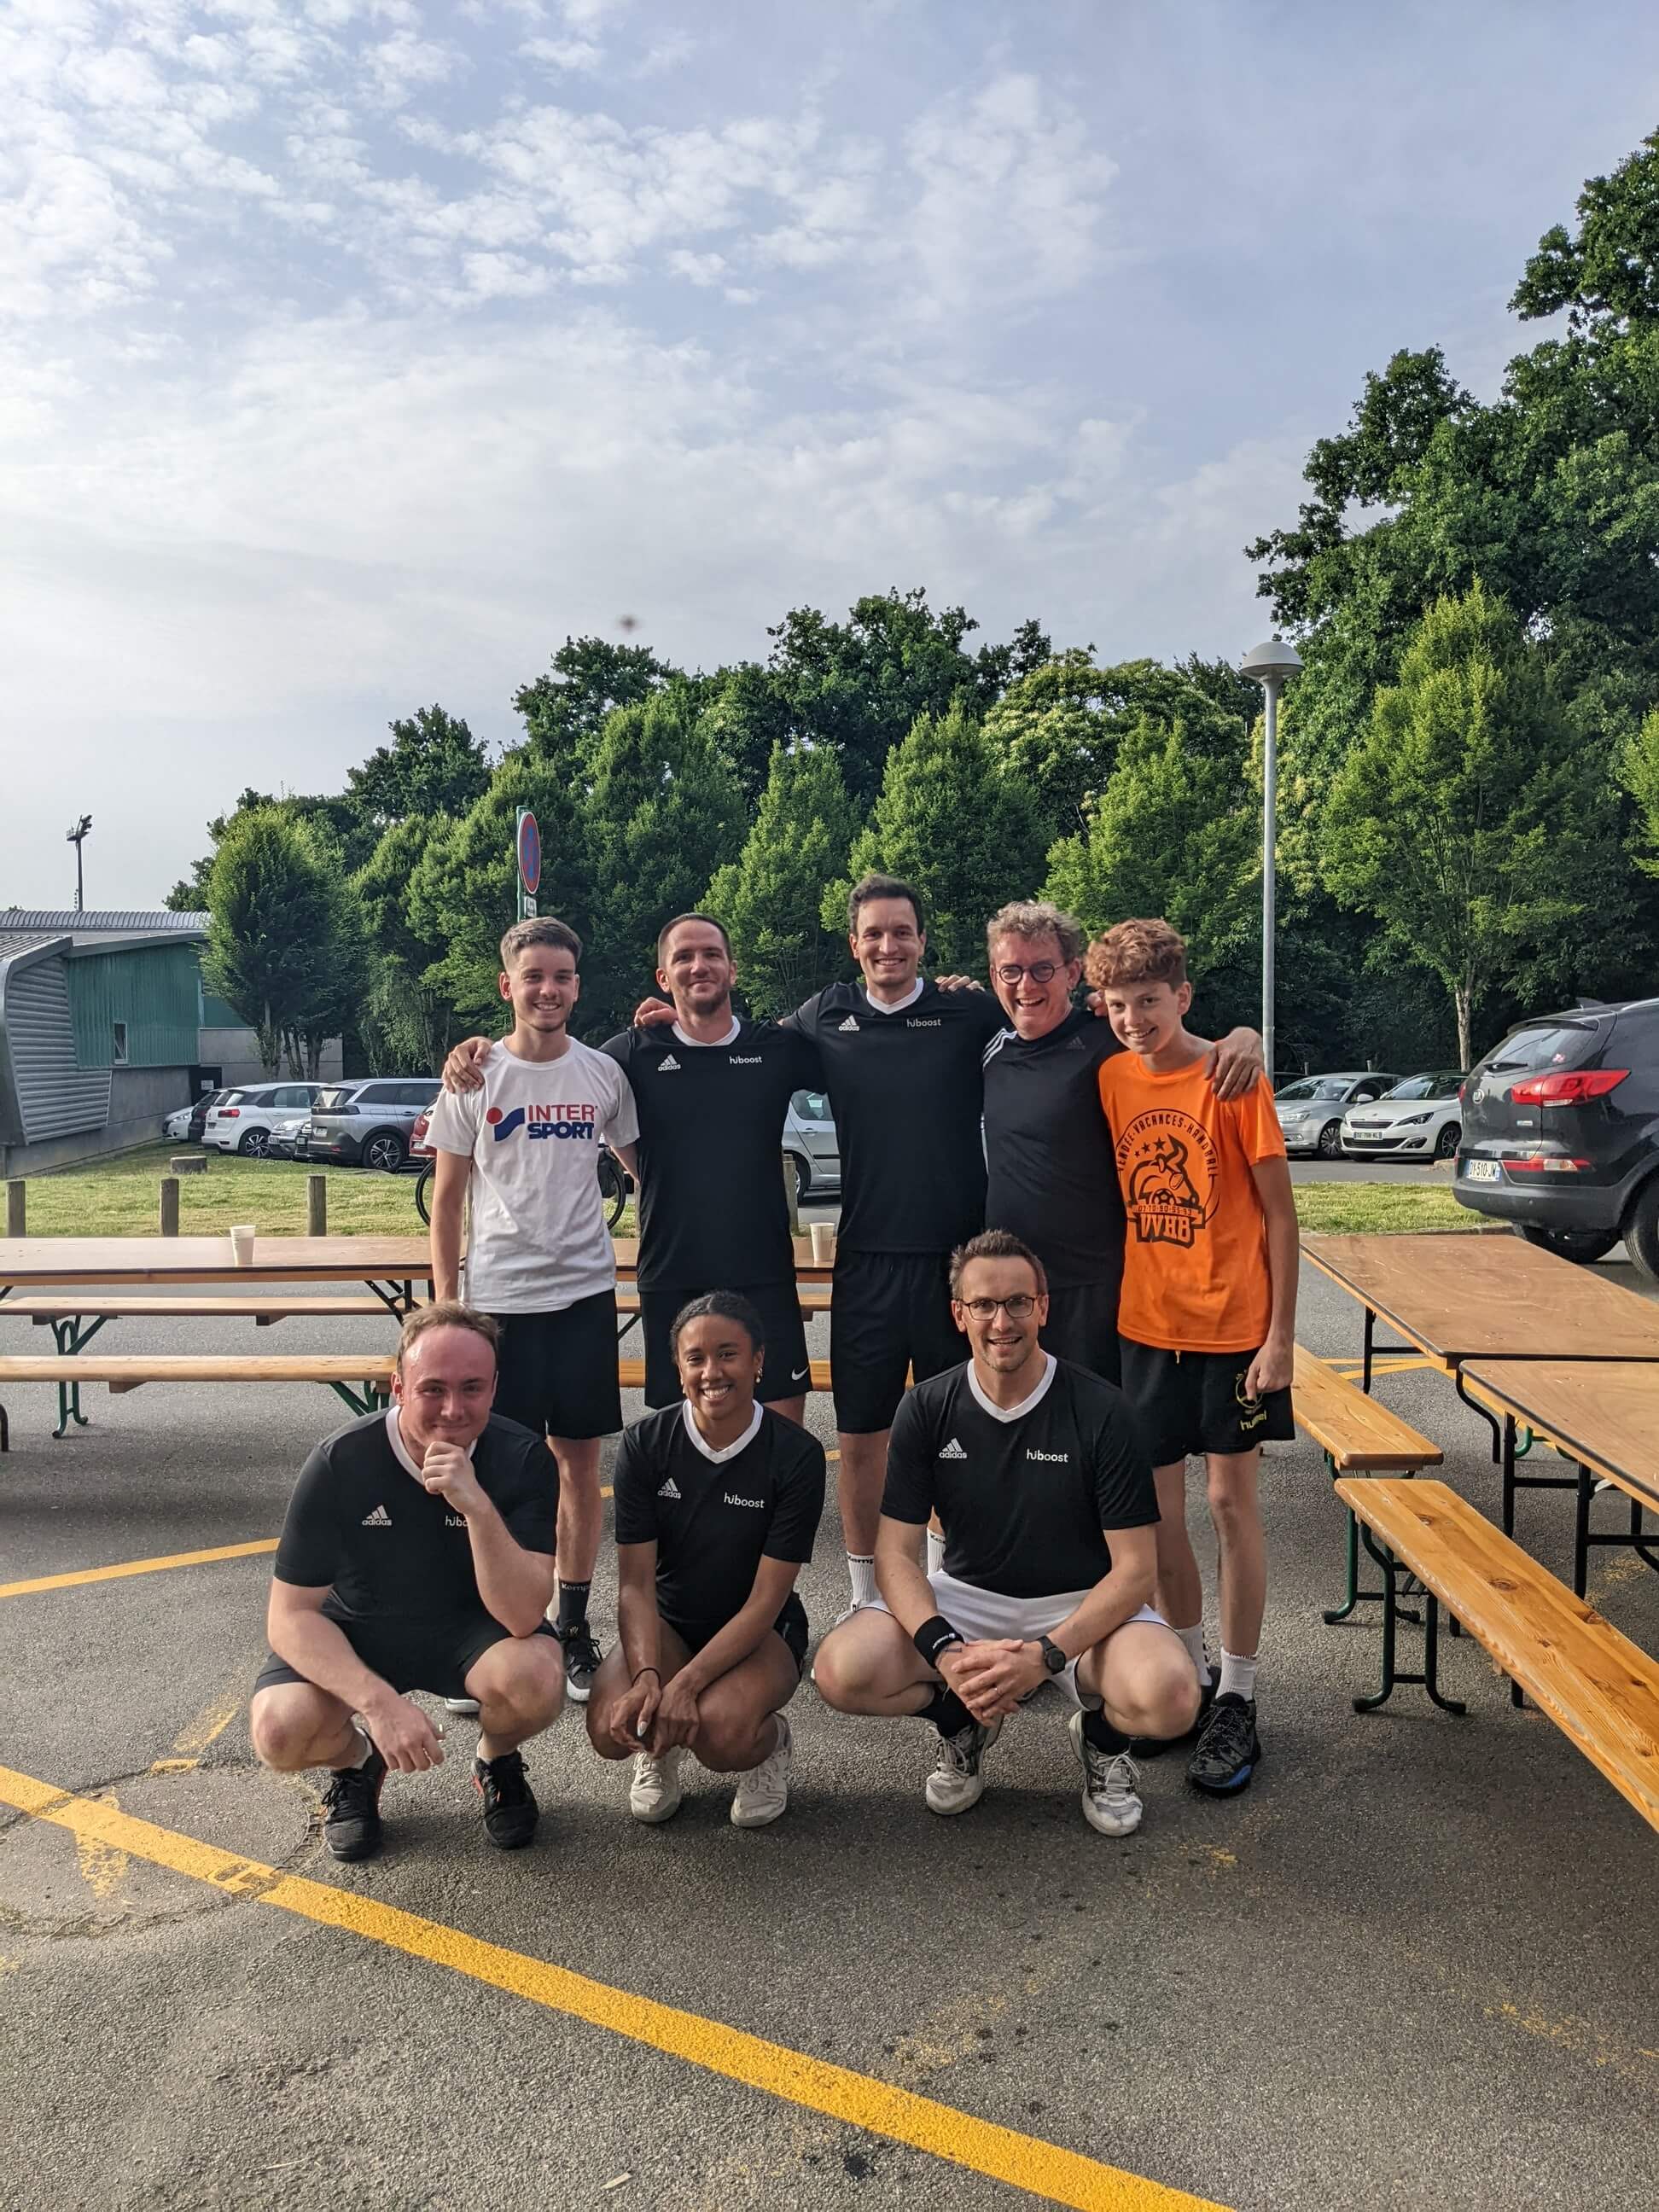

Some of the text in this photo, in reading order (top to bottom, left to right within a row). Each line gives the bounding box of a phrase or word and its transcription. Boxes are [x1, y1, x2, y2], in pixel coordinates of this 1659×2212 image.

[528, 1104, 595, 1121] INTER
[527, 1121, 595, 1140] SPORT
[657, 1489, 682, 1499] adidas
